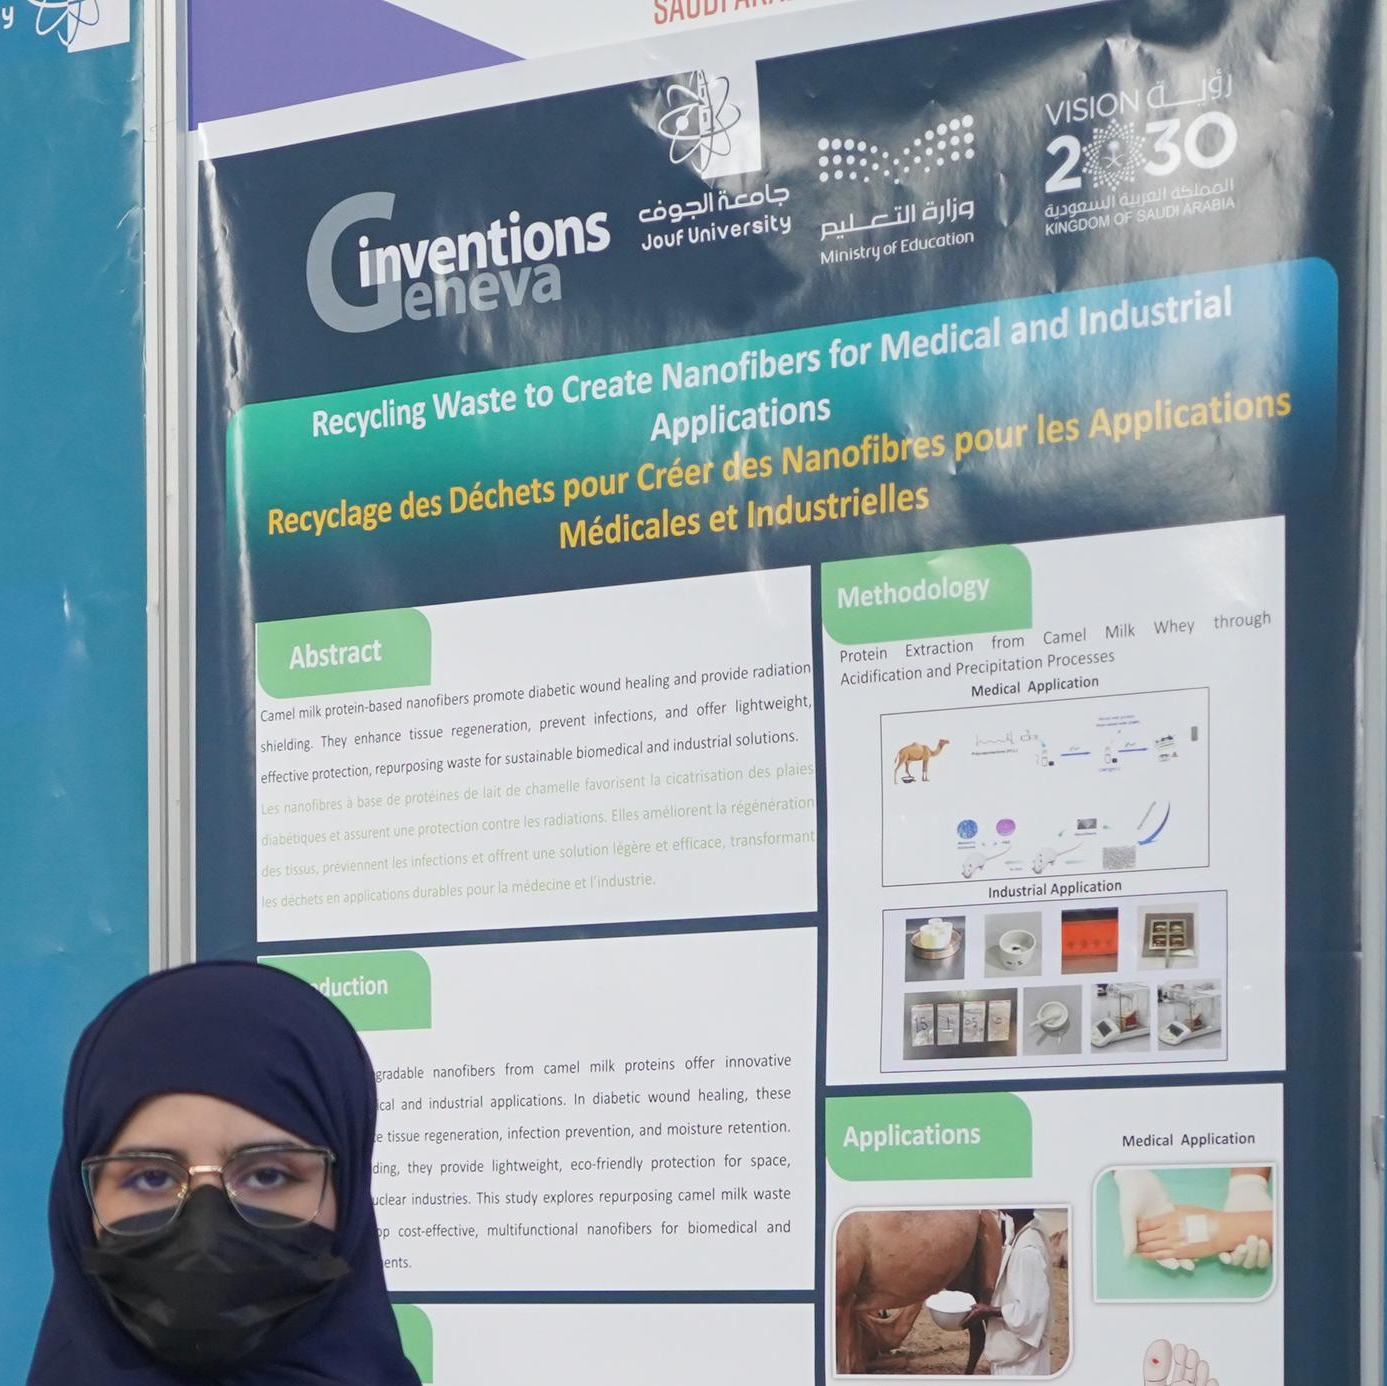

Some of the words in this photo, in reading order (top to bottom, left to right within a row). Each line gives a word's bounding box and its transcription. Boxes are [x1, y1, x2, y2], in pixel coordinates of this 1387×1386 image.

[1045, 88, 1139, 126] VISION
[358, 211, 611, 288] inventions
[641, 221, 684, 251] Jouf
[688, 214, 792, 244] University
[820, 245, 881, 265] Ministry
[882, 240, 898, 256] of
[900, 231, 975, 254] Education
[312, 398, 427, 439] Recycling
[432, 387, 517, 420] Waste
[524, 383, 554, 409] to
[562, 369, 653, 404] Create
[662, 348, 821, 391] Nanofibers
[828, 337, 872, 369] for
[881, 316, 1000, 363] Medical
[1010, 307, 1068, 345] and
[1079, 284, 1232, 336] Industrial
[650, 397, 831, 446] Applications
[268, 498, 393, 537] Recyclage
[399, 490, 442, 521] des
[449, 478, 556, 514] Déchets
[563, 472, 629, 508] pour
[637, 457, 715, 492] Créer
[721, 445, 773, 483] des
[781, 430, 945, 475] Nanofibres
[954, 424, 1028, 460] pour
[1037, 414, 1080, 444] les
[1088, 391, 1293, 443] Applications
[559, 508, 701, 550] Médicales
[709, 504, 738, 533] et
[747, 482, 930, 529] Industrielles
[837, 575, 990, 609] Methodology
[289, 639, 382, 670] Abstract
[839, 647, 888, 663] Protein
[905, 639, 974, 658] Extraction
[991, 634, 1025, 650] from
[1043, 627, 1087, 645] Camel
[1105, 623, 1135, 639] Milk
[1153, 619, 1195, 635] Whey
[1214, 610, 1272, 630] through
[260, 707, 295, 723] Camel
[298, 704, 322, 719] milk
[325, 697, 403, 720] protein-based
[406, 693, 470, 709] nanofibers
[473, 689, 525, 707] promote
[528, 682, 576, 699] diabetic
[579, 677, 621, 694] wound
[625, 674, 670, 690] healing
[673, 670, 697, 686] and
[701, 666, 749, 686] provide
[752, 657, 814, 684] radiation
[971, 681, 1021, 697] Medical
[1027, 676, 1099, 695] Application
[988, 883, 1047, 899] Industrial
[1050, 879, 1125, 900] Application
[842, 1122, 981, 1152] Applications
[1122, 1133, 1173, 1147] Medical
[1180, 1132, 1256, 1149] Application
